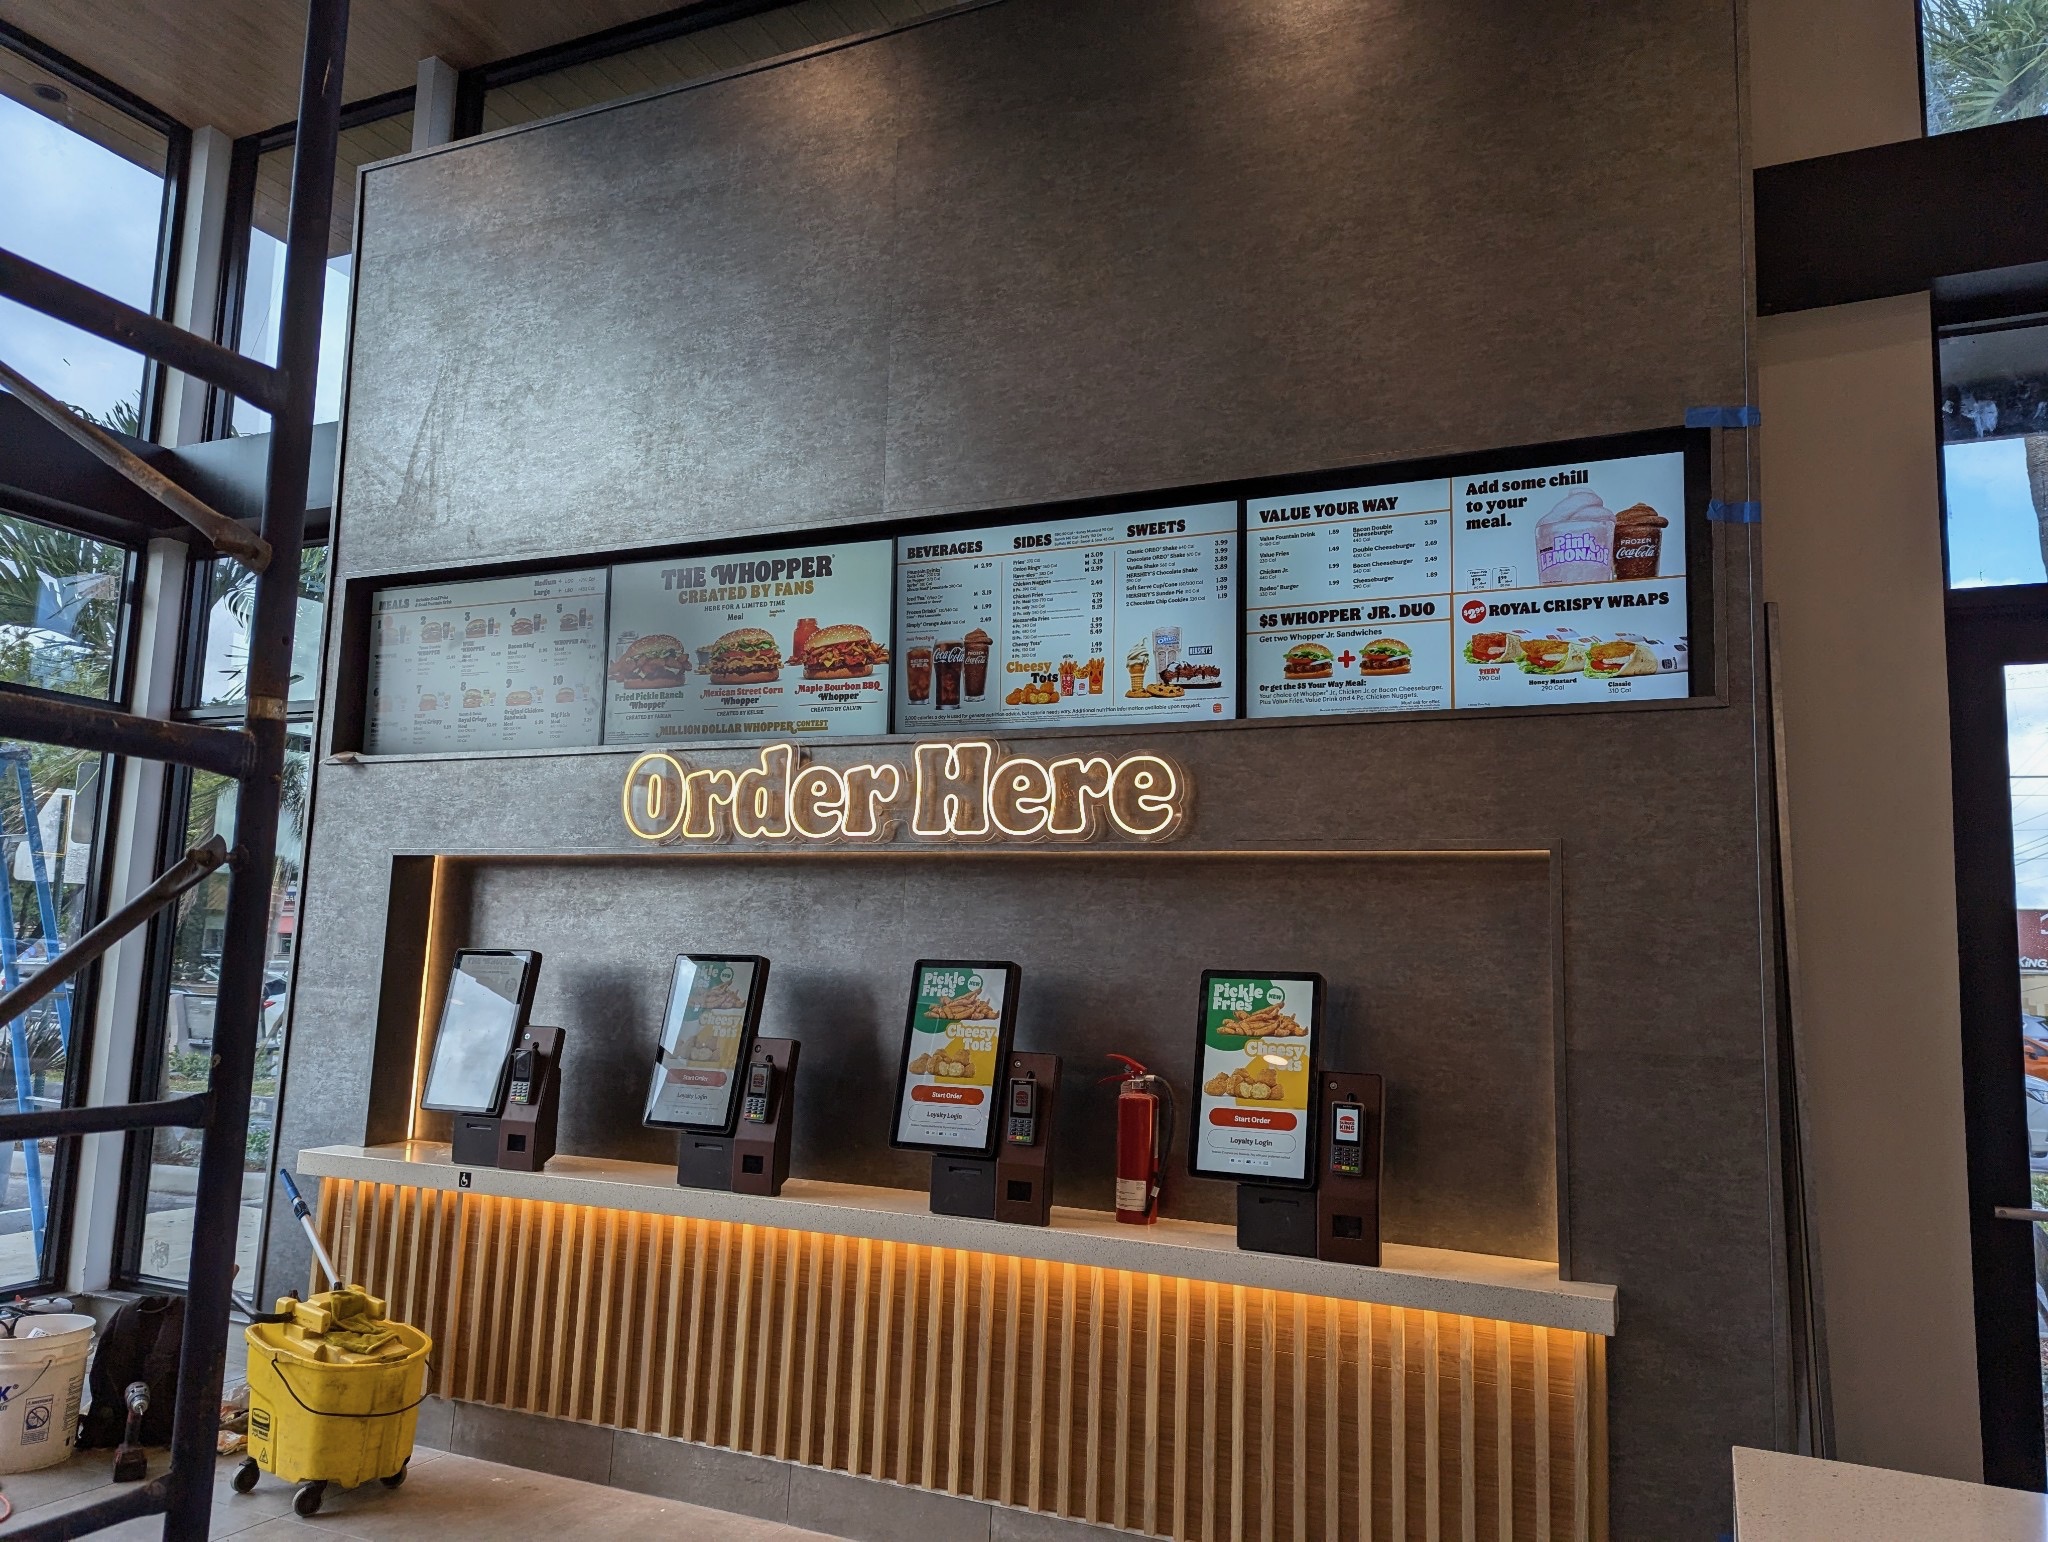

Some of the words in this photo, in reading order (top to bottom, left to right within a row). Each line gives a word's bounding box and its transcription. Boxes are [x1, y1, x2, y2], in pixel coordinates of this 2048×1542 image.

[1466, 479, 1498, 495] Add
[1502, 475, 1546, 491] some
[1549, 470, 1588, 486] chill
[1259, 506, 1311, 524] VALUE
[1314, 501, 1359, 518] YOUR
[1362, 496, 1398, 513] WAY
[1466, 500, 1482, 513] to
[1486, 497, 1528, 514] your
[1127, 519, 1186, 538] SWEETS
[1466, 514, 1512, 530] meal.
[1352, 529, 1394, 538] Cheeseburger
[1014, 534, 1052, 550] SIDES
[1374, 543, 1416, 552] Cheeseburger
[1554, 533, 1597, 552] Pink
[1620, 537, 1651, 546] FROZEN
[907, 541, 983, 560] BEVERAGES
[1616, 544, 1656, 559] Coca-Cola
[1372, 559, 1414, 568] Cheeseburger
[1540, 548, 1608, 571] LEMONADE
[660, 567, 706, 590] THE
[711, 556, 832, 586] WHOPPER
[678, 584, 748, 604] CREATED
[751, 584, 772, 598] BY
[774, 580, 814, 596] FANS
[379, 598, 410, 611] MEALS
[556, 604, 562, 614] 5
[1488, 602, 1540, 616] ROYAL
[1543, 597, 1604, 613] CRISPY
[1606, 592, 1670, 608] WRAPS
[464, 612, 470, 622] 3
[510, 608, 516, 618] 4
[727, 613, 744, 621] Meal
[1260, 614, 1278, 628] $5
[1281, 608, 1361, 626] WHOPPER
[1367, 606, 1396, 620] JR.
[1400, 602, 1435, 618] DUO
[420, 616, 426, 626] 2
[1290, 633, 1324, 643] Whopper
[1336, 628, 1382, 638] Sandwiches
[1006, 661, 1052, 674] Cheesy
[506, 678, 512, 688] 9
[553, 674, 564, 686] 10
[1030, 672, 1058, 684] Tots
[374, 688, 379, 696] 6
[416, 684, 422, 694] 7
[460, 682, 466, 692] 8
[700, 688, 736, 700] Mexican
[736, 688, 762, 696] Street
[762, 686, 784, 694] Corn
[795, 685, 824, 694] Maple
[824, 682, 862, 692] Bourbon
[862, 680, 884, 692] BBQ
[1270, 684, 1282, 692] get
[1328, 681, 1344, 690] Way
[614, 692, 634, 702] Fried
[636, 690, 659, 700] Pickle
[660, 690, 684, 700] Ranch
[721, 697, 759, 706] Whopper
[818, 692, 859, 702] Whopper
[629, 702, 665, 710] Whopper
[656, 725, 700, 738] MILLION
[702, 724, 742, 734] DOLLAR
[744, 722, 797, 734] WHOPPER
[622, 744, 900, 838] Order
[912, 742, 1176, 838] Here
[924, 972, 966, 988] Pickle
[922, 984, 956, 998] Fries
[1214, 983, 1264, 1002] Pickle
[1212, 996, 1252, 1012] Fries
[700, 1012, 740, 1028] Cheesy
[712, 1026, 738, 1038] Tots
[947, 1024, 994, 1041] Cheesy
[963, 1038, 992, 1052] Tots
[1246, 1041, 1304, 1060] Cheesy
[926, 1111, 946, 1120] Loyalty
[1230, 1137, 1254, 1146] Loyalty
[1254, 1139, 1273, 1148] Login
